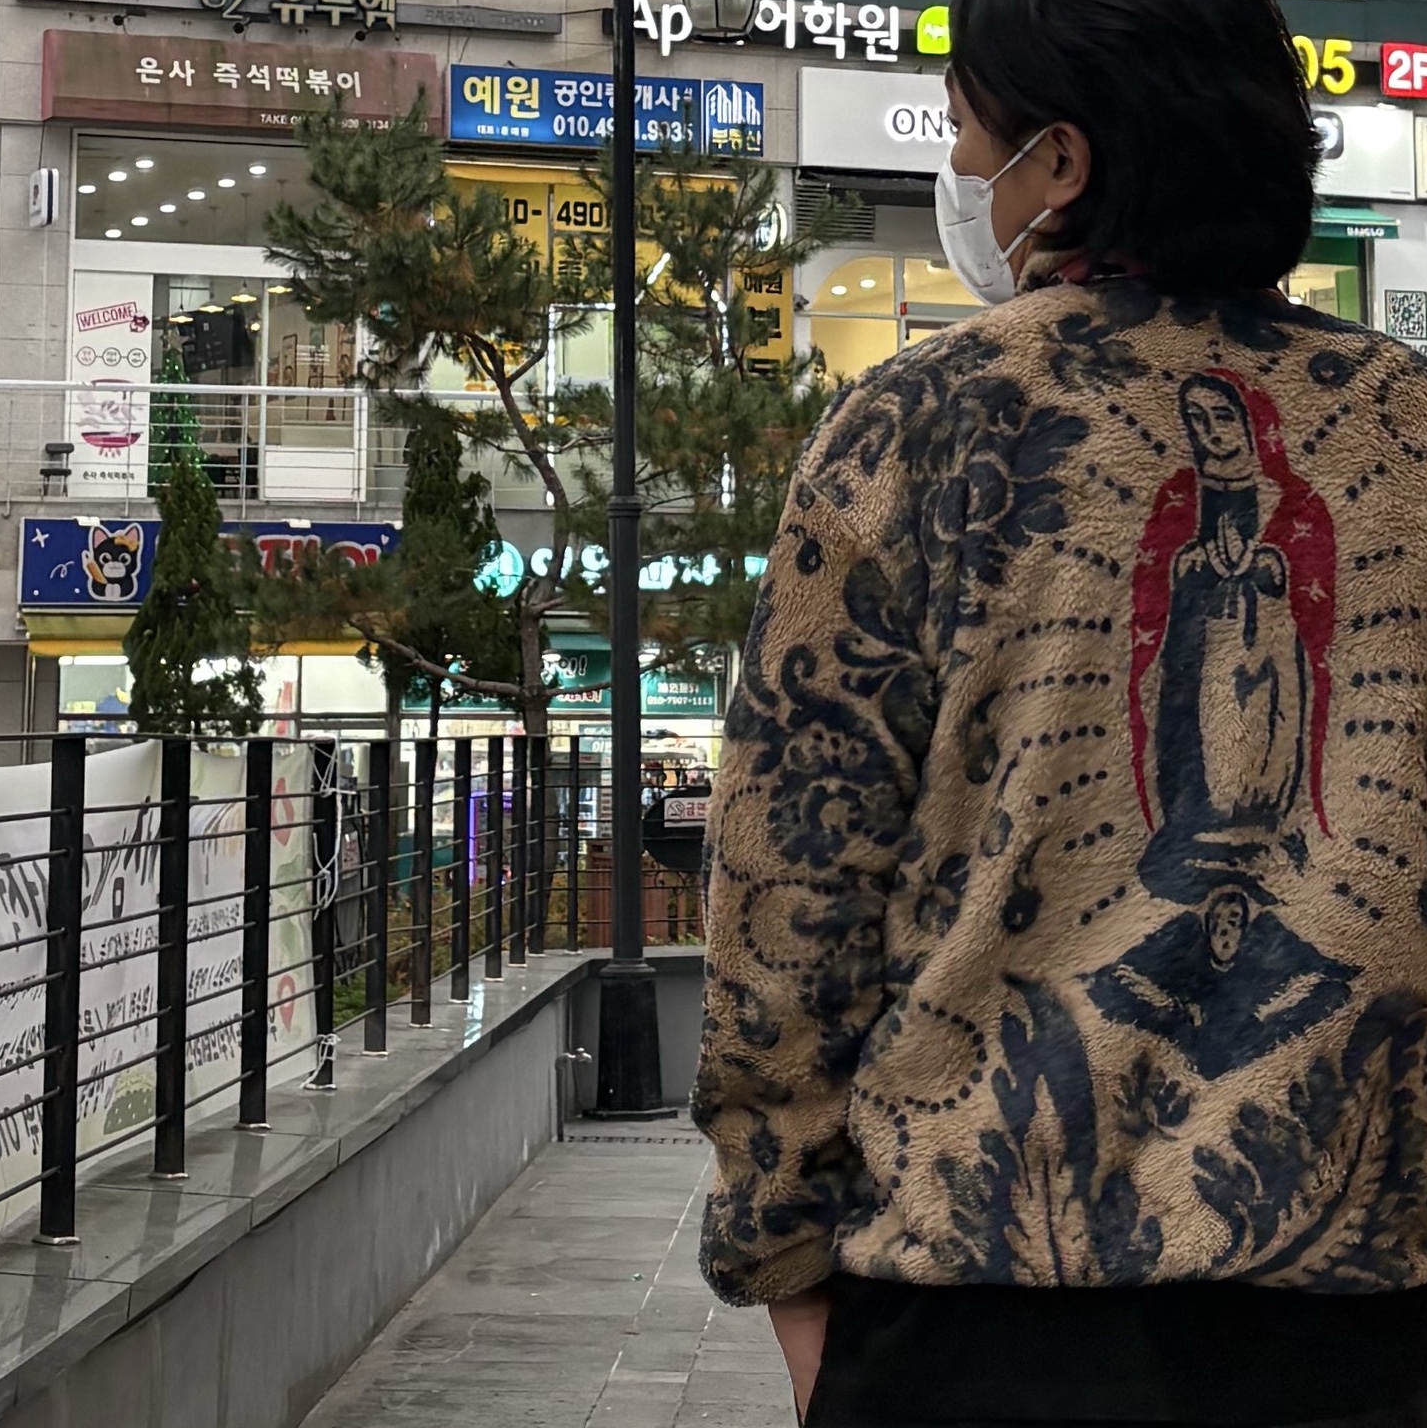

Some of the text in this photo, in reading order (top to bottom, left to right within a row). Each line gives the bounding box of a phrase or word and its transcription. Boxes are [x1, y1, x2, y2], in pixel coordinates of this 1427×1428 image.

[135, 56, 362, 98] 은사 즉석떡볶이
[463, 74, 682, 120] 예원 공인개사
[78, 304, 135, 328] WELCOME
